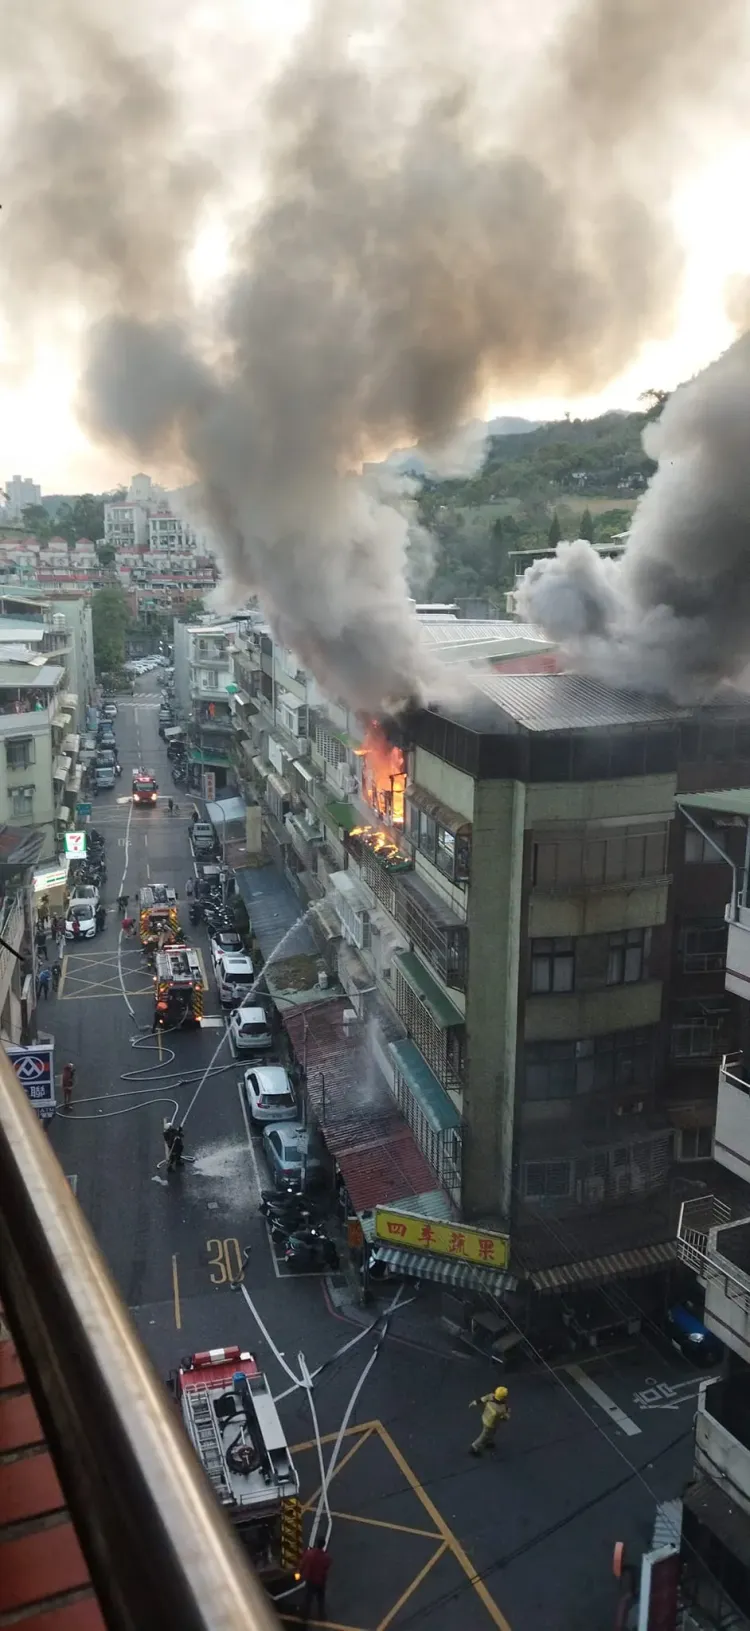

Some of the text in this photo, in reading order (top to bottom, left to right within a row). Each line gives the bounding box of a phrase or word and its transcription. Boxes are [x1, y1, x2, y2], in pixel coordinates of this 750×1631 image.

[206, 1238, 245, 1283] 30
[386, 1221, 495, 1261] 四季蔬果
